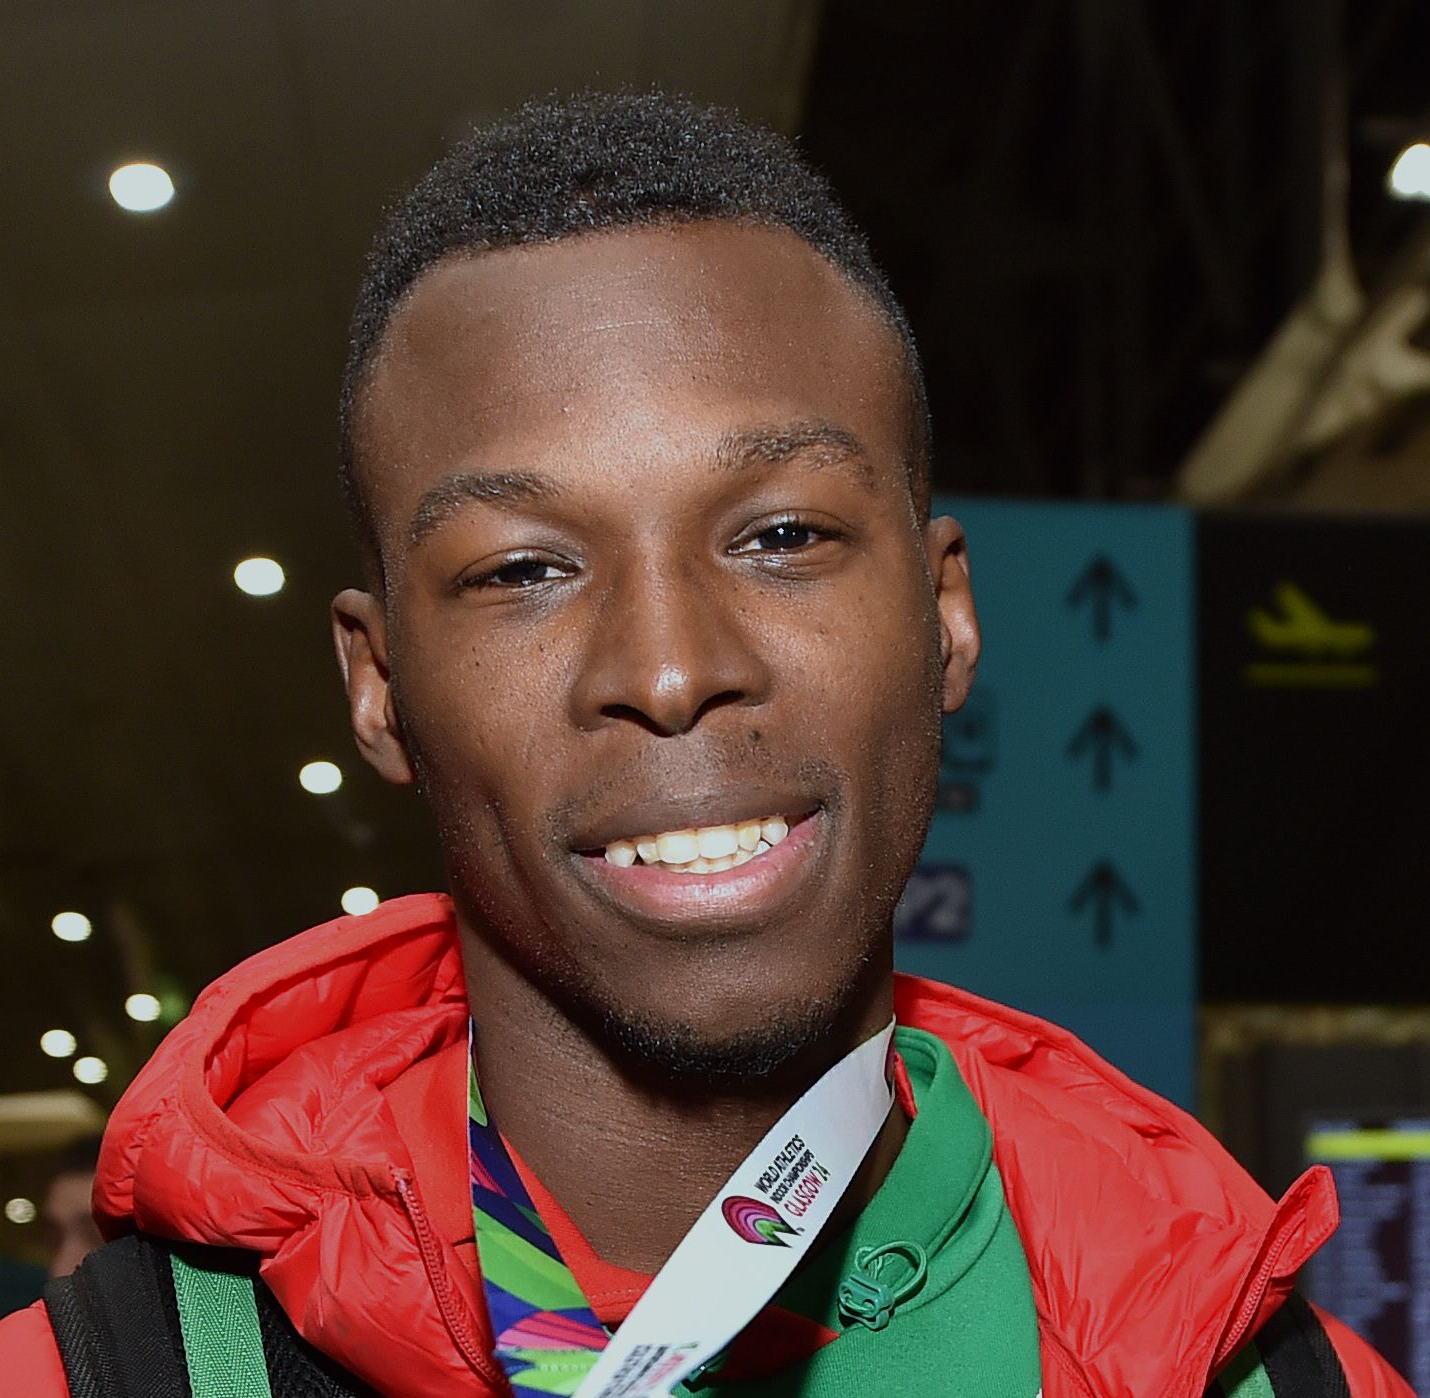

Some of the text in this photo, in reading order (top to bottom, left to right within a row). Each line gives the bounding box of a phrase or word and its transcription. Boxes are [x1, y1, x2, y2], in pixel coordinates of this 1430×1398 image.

[754, 1134, 805, 1194] WORLD ATHLETICS
[784, 1162, 831, 1217] GLASGOW 24
